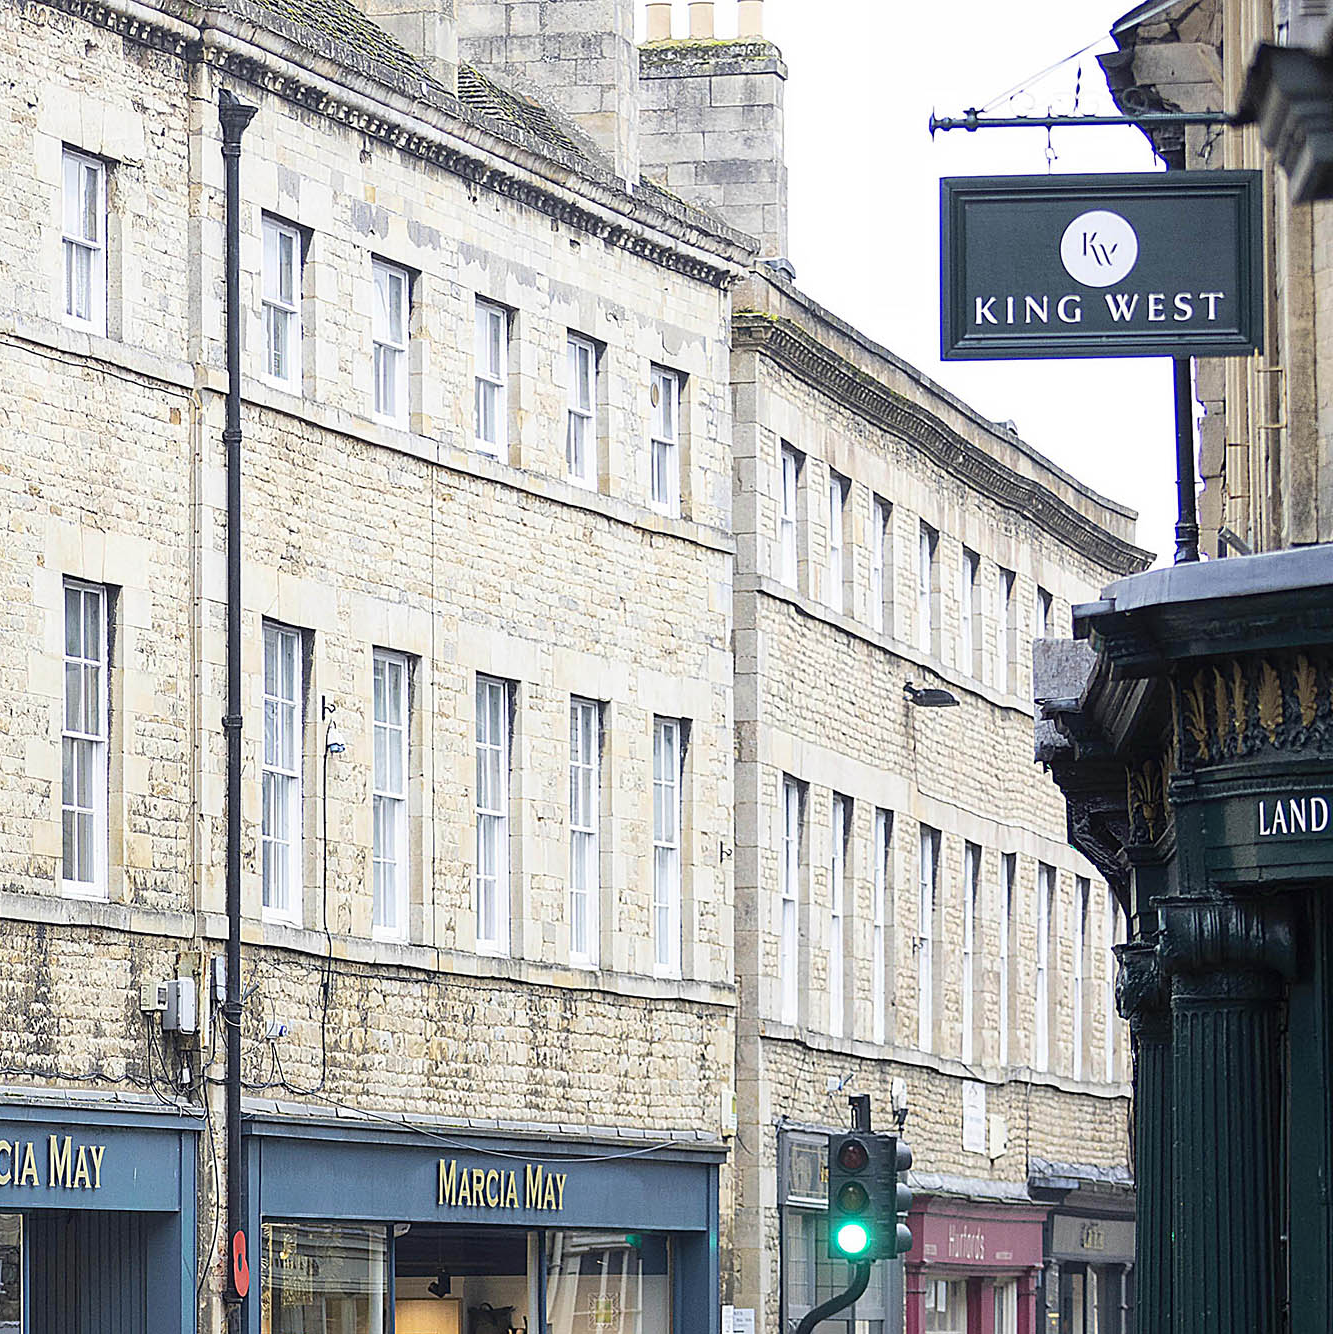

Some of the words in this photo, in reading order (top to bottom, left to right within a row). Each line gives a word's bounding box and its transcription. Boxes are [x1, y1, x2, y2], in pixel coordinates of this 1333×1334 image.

[974, 295, 1083, 325] KING
[1104, 292, 1226, 322] WEST
[1258, 796, 1329, 836] LAND
[948, 1224, 985, 1260] Hurfords
